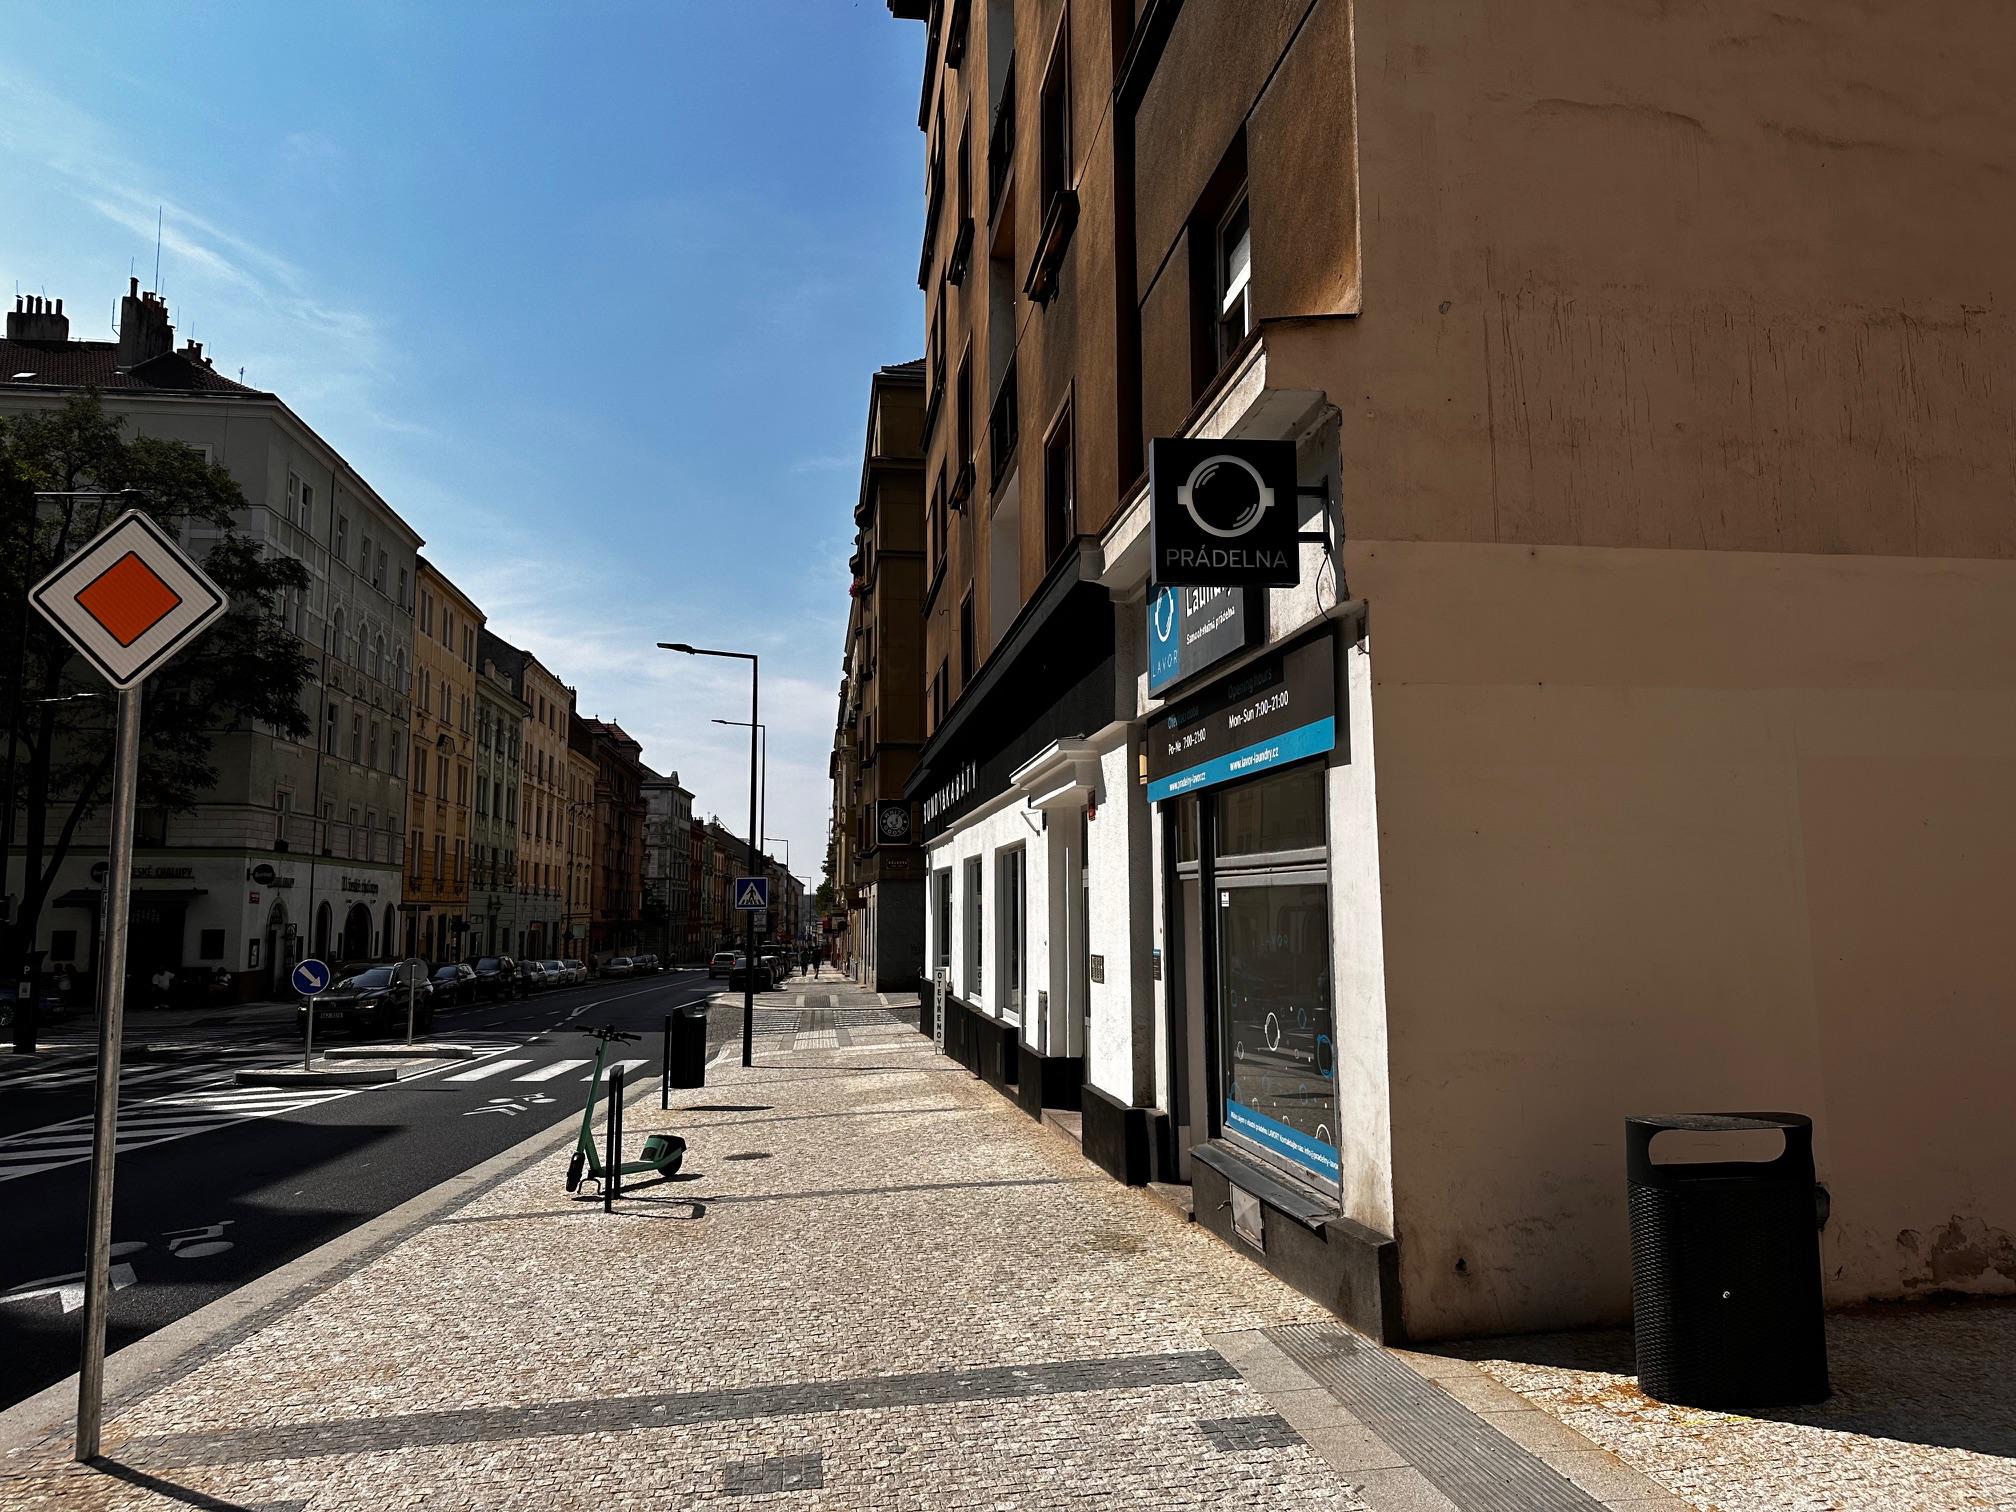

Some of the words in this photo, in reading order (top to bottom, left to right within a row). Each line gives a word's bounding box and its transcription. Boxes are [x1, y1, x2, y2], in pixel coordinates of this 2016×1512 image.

[1166, 544, 1289, 568] PRÁDELNA
[1152, 649, 1179, 678] LAVOR
[1229, 746, 1279, 772] www.lavor-laundry.cz
